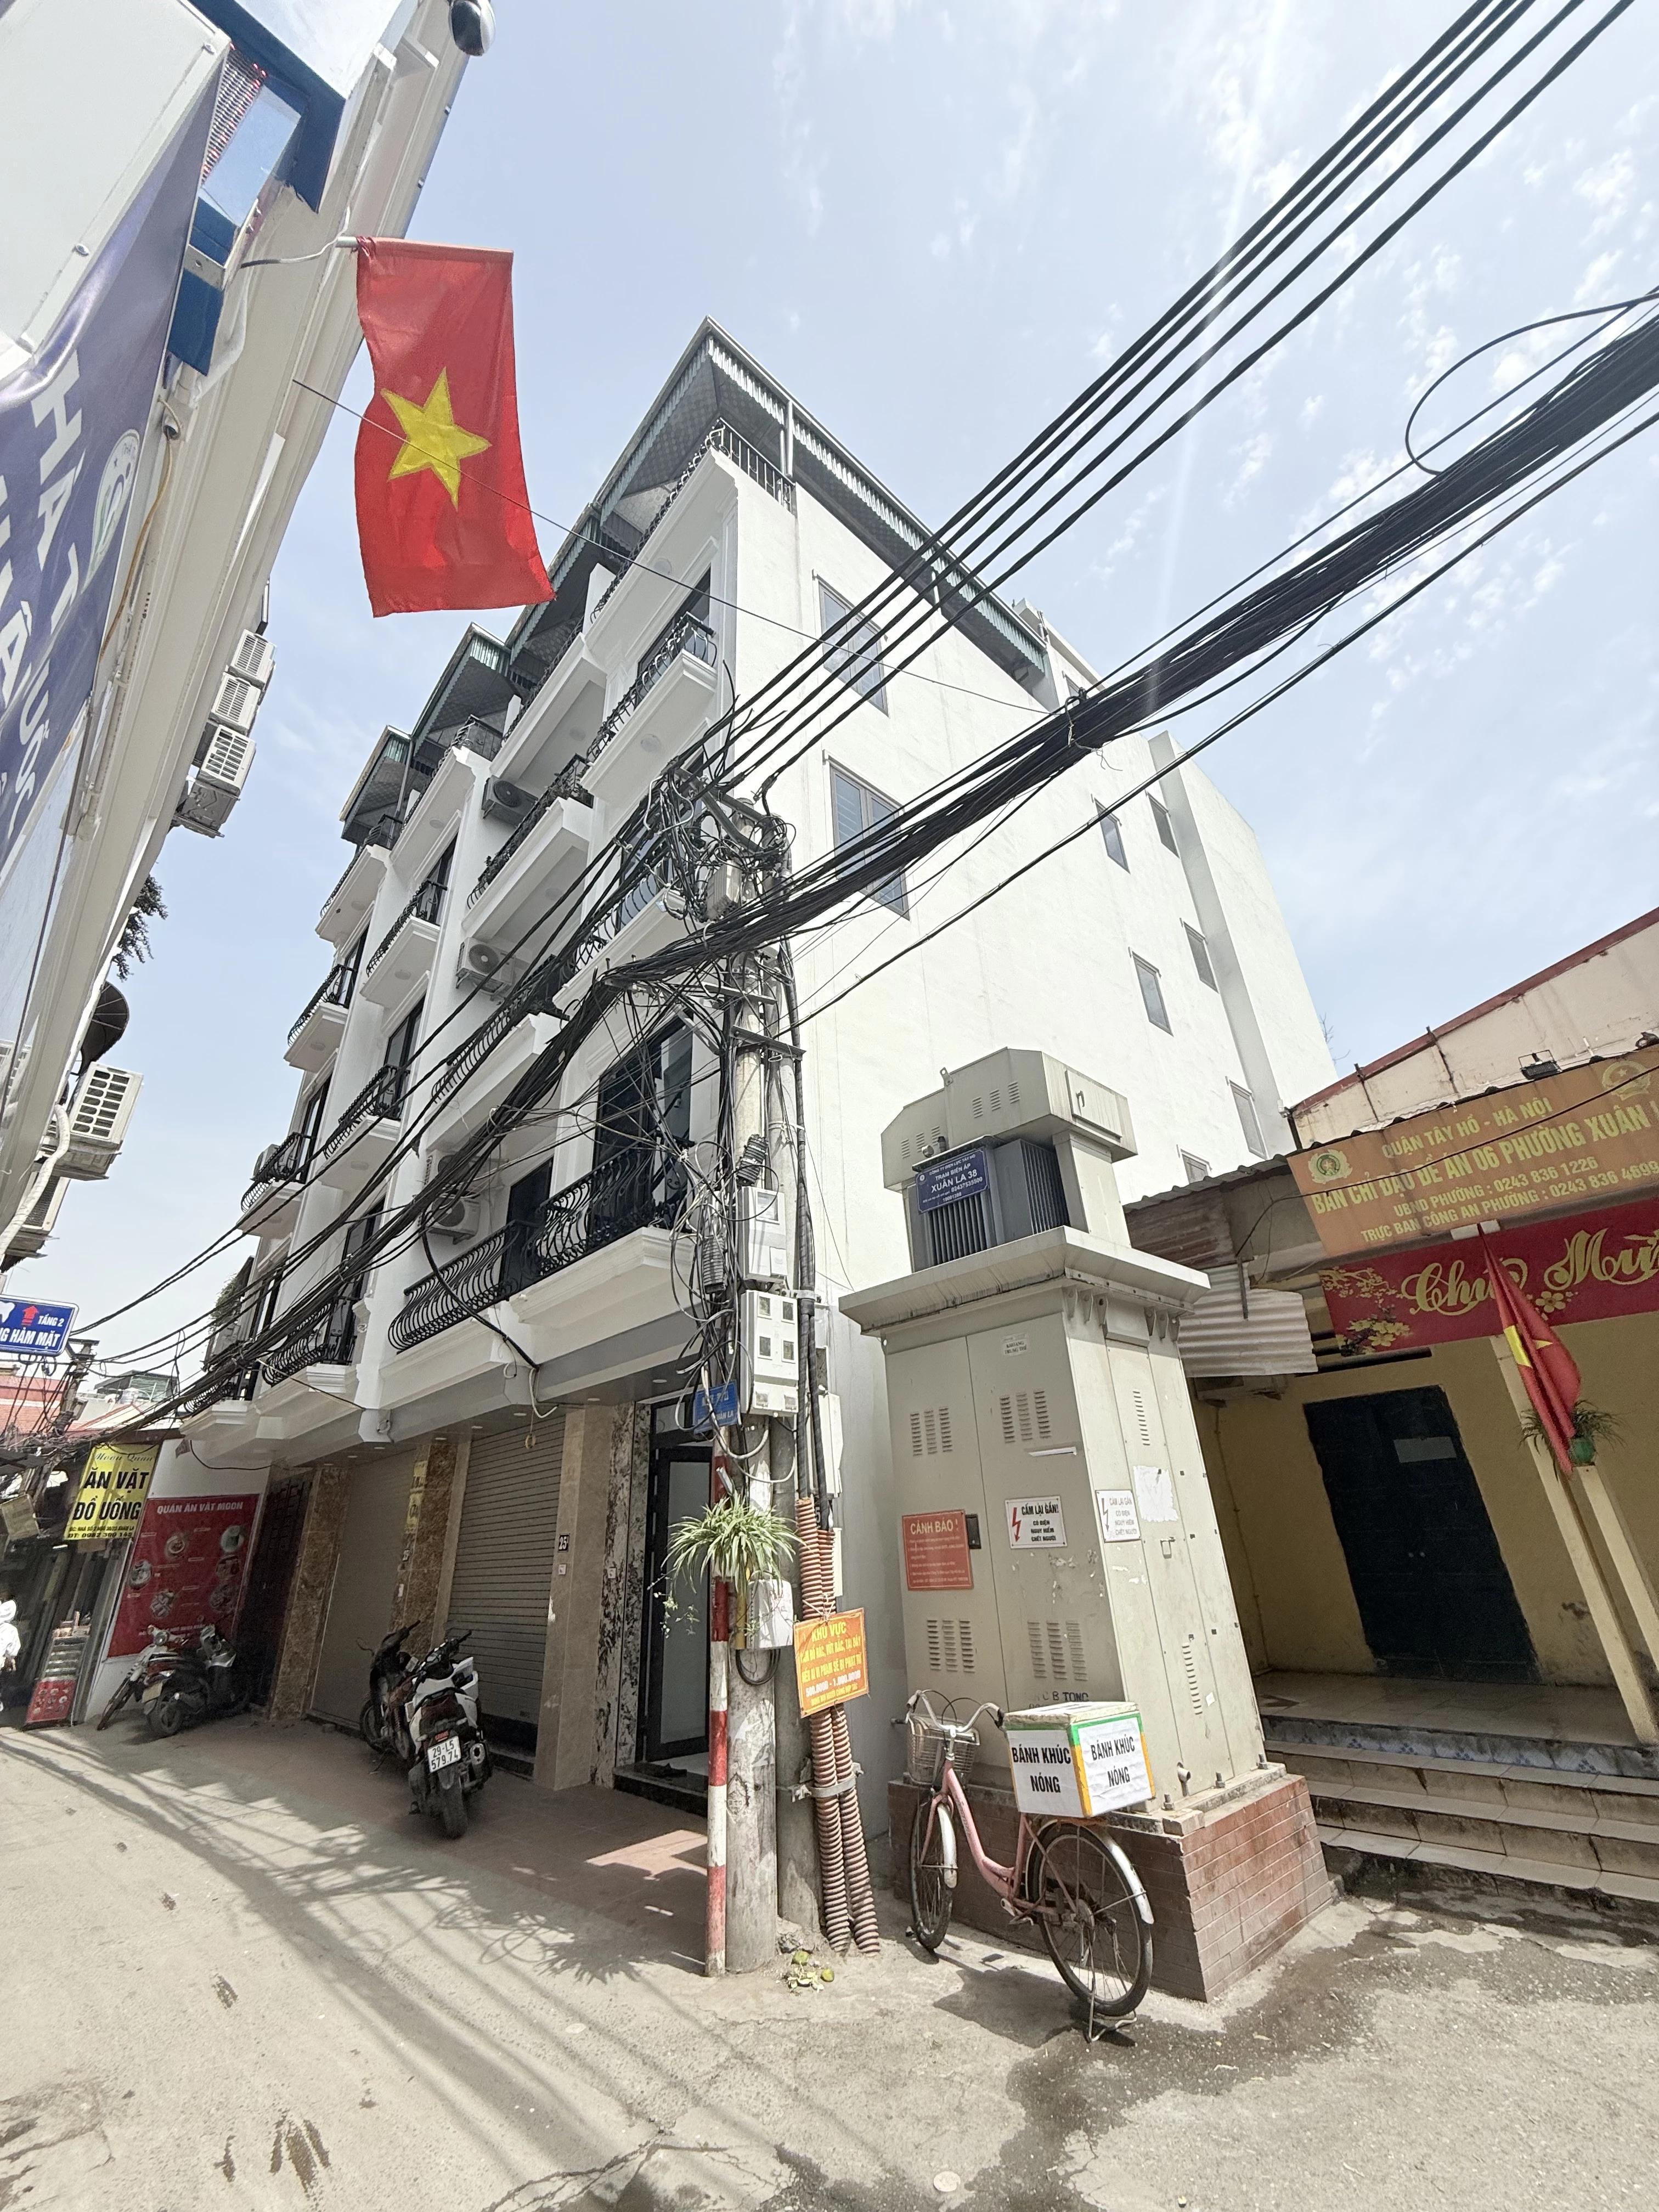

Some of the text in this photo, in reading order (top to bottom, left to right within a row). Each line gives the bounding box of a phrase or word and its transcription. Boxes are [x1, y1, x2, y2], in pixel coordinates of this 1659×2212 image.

[31, 349, 86, 569] HÀ
[1381, 1136, 1424, 1158] QUẬN
[1424, 1126, 1454, 1146] TÂY
[1456, 1114, 1480, 1137] HỒ
[1492, 1105, 1519, 1126] HÀ
[1519, 1097, 1553, 1119] NỘI
[1311, 1188, 1348, 1214] BAN
[1348, 1171, 1379, 1204] CHỈ
[1379, 1169, 1416, 1198] ĐẠO
[1416, 1154, 1443, 1187] ĐỀ
[1443, 1152, 1474, 1180] ÁN
[1472, 1146, 1500, 1171] 06
[1498, 1122, 1587, 1164] PHƯỜNG
[1584, 1104, 1651, 1142] XUÂN
[931, 1169, 977, 1193] XUÂN LA 38
[1393, 1198, 1429, 1217] UBND
[1430, 1184, 1485, 1208] PHƯỜNG
[1493, 1173, 1529, 1192] 0243
[1530, 1166, 1559, 1183] 836
[1560, 1156, 1598, 1176] 1226
[1361, 1224, 1392, 1242] TRỰC
[1393, 1217, 1421, 1234] BAN
[1423, 1209, 1459, 1228] CÔNG
[1460, 1203, 1481, 1218] AN
[1481, 1189, 1540, 1214] PHƯỜNG
[1549, 1178, 1587, 1197] 0243
[1589, 1170, 1618, 1188] 836
[57, 1318, 65, 1327] 2
[35, 1330, 61, 1350] MẶT
[83, 1467, 149, 1493] ĂN VẶT
[72, 1496, 142, 1520] ĐỒ UỐNG
[157, 1502, 244, 1515] QUÁN ĂN VẶT MOON
[1022, 1503, 1034, 1515] CẤM
[910, 1520, 933, 1534] CẢNH
[935, 1517, 953, 1532] BÁO
[830, 1621, 847, 1638] VỰC
[432, 1740, 454, 1758] 29-L5
[1011, 1743, 1071, 1765] BÁNH KHÚC
[1090, 1734, 1136, 1761] BÁNH KHÚC
[431, 1750, 458, 1770] 579.74
[1030, 1772, 1061, 1793] NÓNG
[1107, 1765, 1130, 1787] NÓNG
